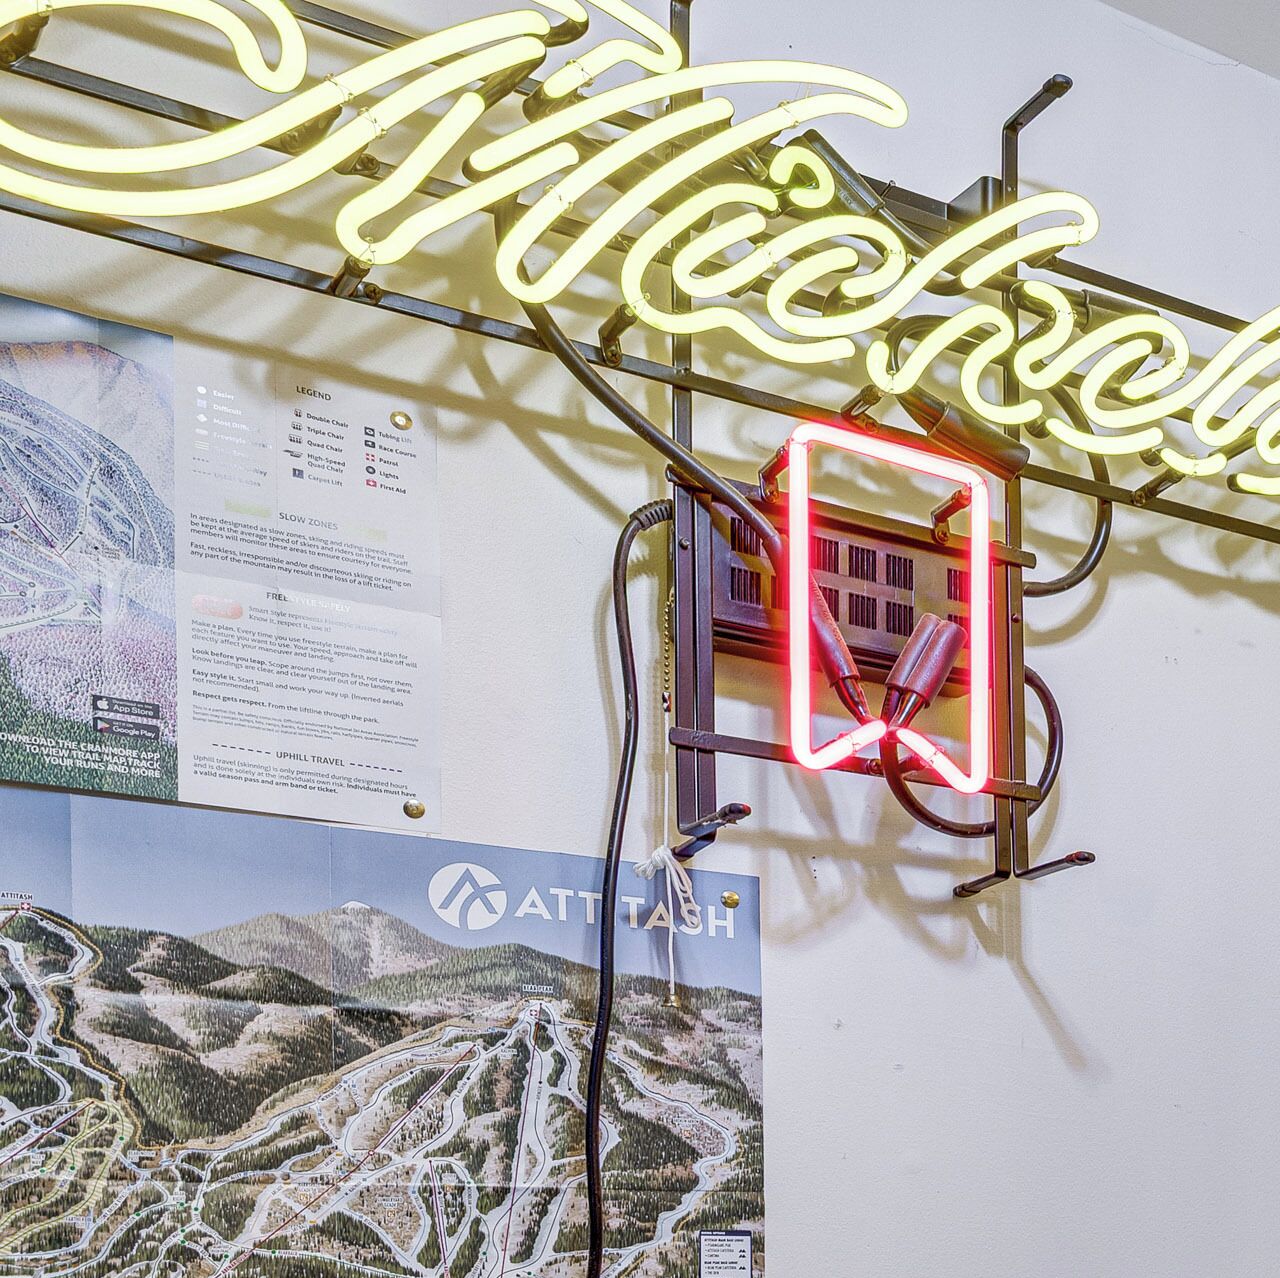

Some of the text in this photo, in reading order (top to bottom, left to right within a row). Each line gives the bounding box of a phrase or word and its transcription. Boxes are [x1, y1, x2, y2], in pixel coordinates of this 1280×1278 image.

[296, 386, 332, 401] LEGEND
[306, 412, 349, 429] Double Chair
[306, 426, 345, 441] Triple Chair
[379, 431, 412, 444] Tubing Lift
[307, 440, 344, 454] Quad Chair
[379, 444, 417, 458] Race Course
[307, 452, 346, 468] High-Speed
[308, 460, 344, 474] Quad Chair
[379, 458, 398, 467] Patrol
[308, 474, 343, 487] Carpet Lift
[379, 471, 399, 481] Lights
[380, 484, 406, 495] First Aid
[279, 512, 338, 530] SLOW ZONES
[190, 541, 205, 551] Fast,
[207, 544, 237, 557] reckless,
[239, 550, 283, 565] irresponsible
[285, 558, 307, 568] and/or
[309, 563, 351, 576] discourteous
[353, 571, 372, 582] skiing
[382, 576, 401, 587] riding
[113, 704, 153, 716] App Store
[113, 726, 155, 738] Google Play
[25, 744, 39, 753] TO
[42, 747, 69, 757] VIEW
[72, 750, 101, 761] TRAIL
[58, 740, 78, 749] THE
[80, 743, 138, 758] CRANMORE
[141, 751, 160, 760] APP
[276, 750, 344, 766] UPHILL TRAVEL
[44, 755, 160, 778] YOUR RUNS AND MORE
[514, 886, 735, 938] ATTTASH
